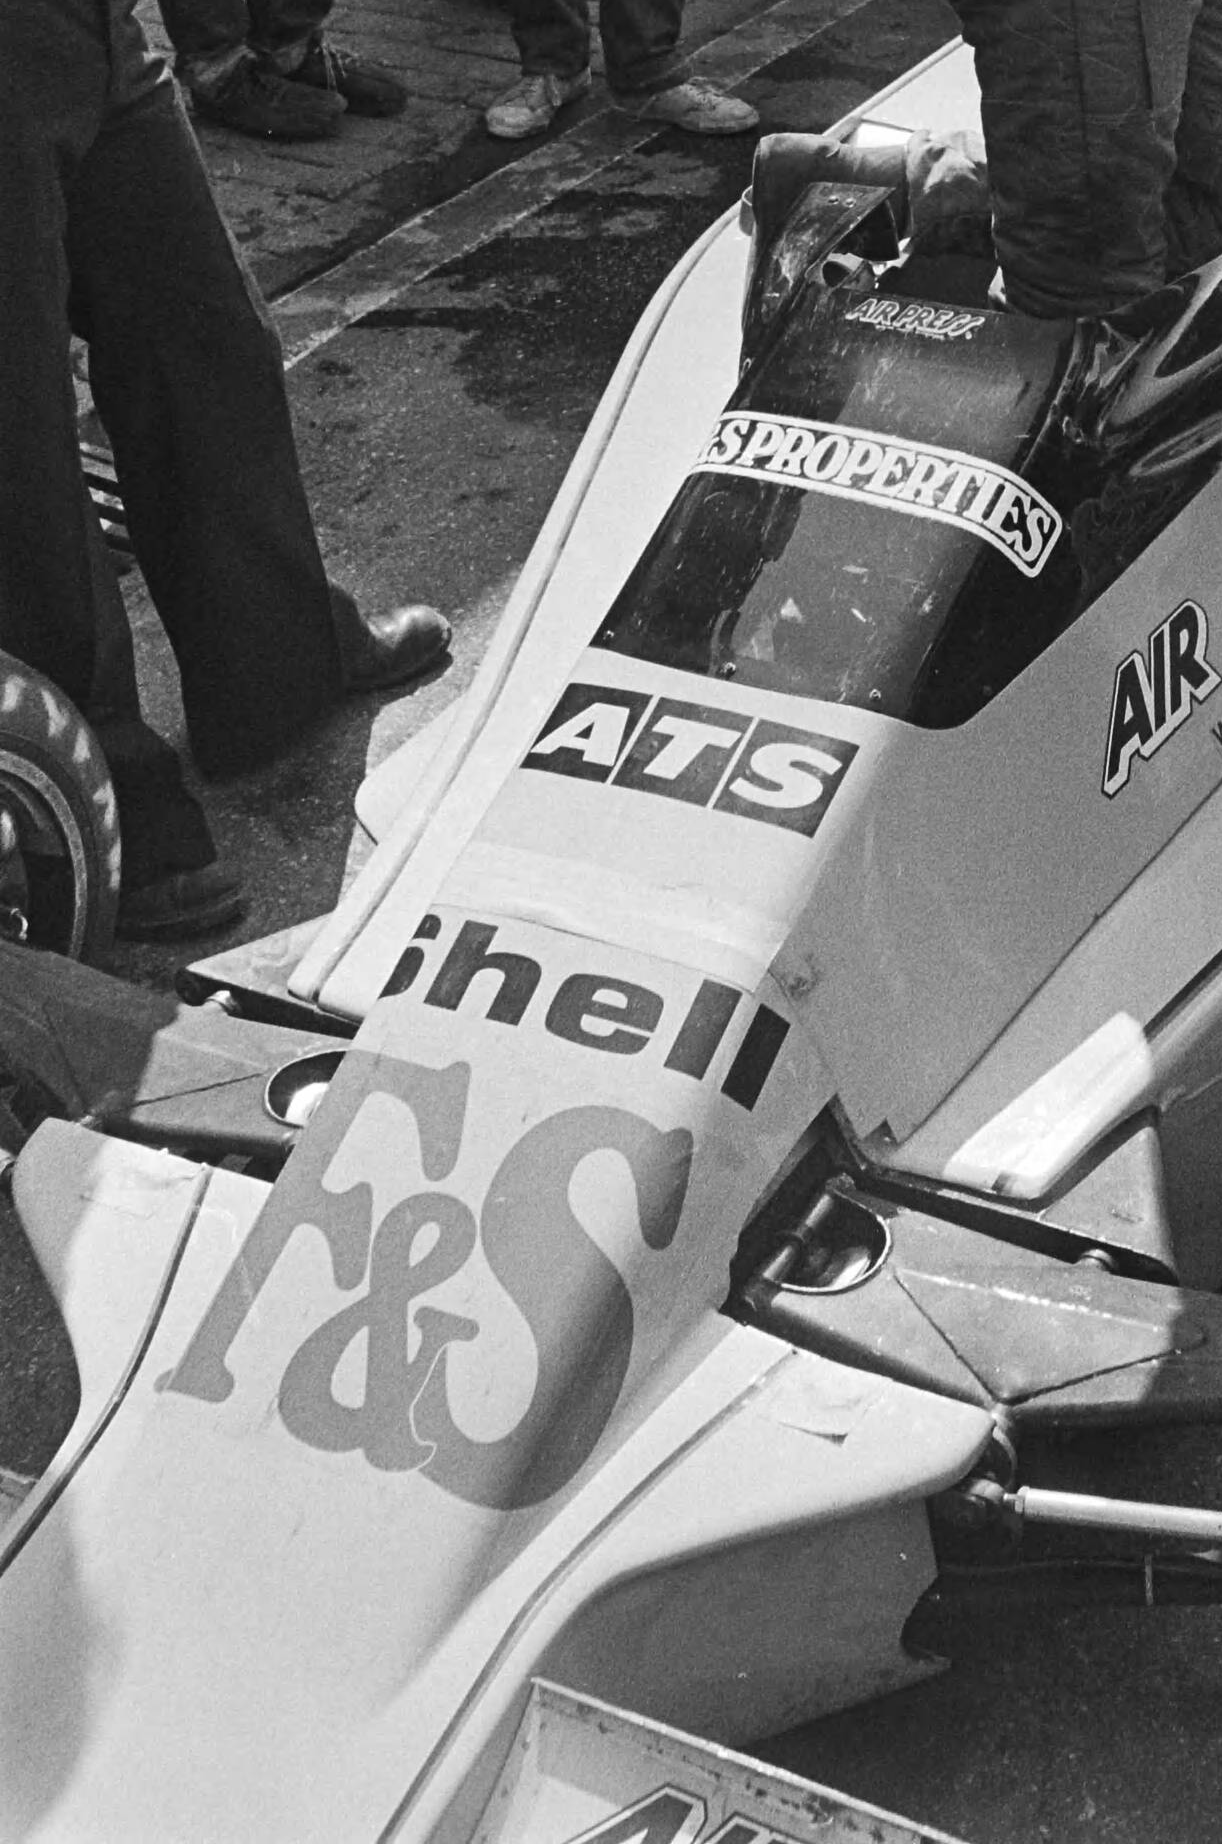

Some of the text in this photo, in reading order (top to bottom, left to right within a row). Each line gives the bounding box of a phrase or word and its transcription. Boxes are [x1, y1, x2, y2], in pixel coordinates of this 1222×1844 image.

[844, 298, 900, 326] AIR
[892, 304, 986, 337] PRESS
[529, 702, 843, 809] ATS
[153, 1049, 694, 1511] F&S
